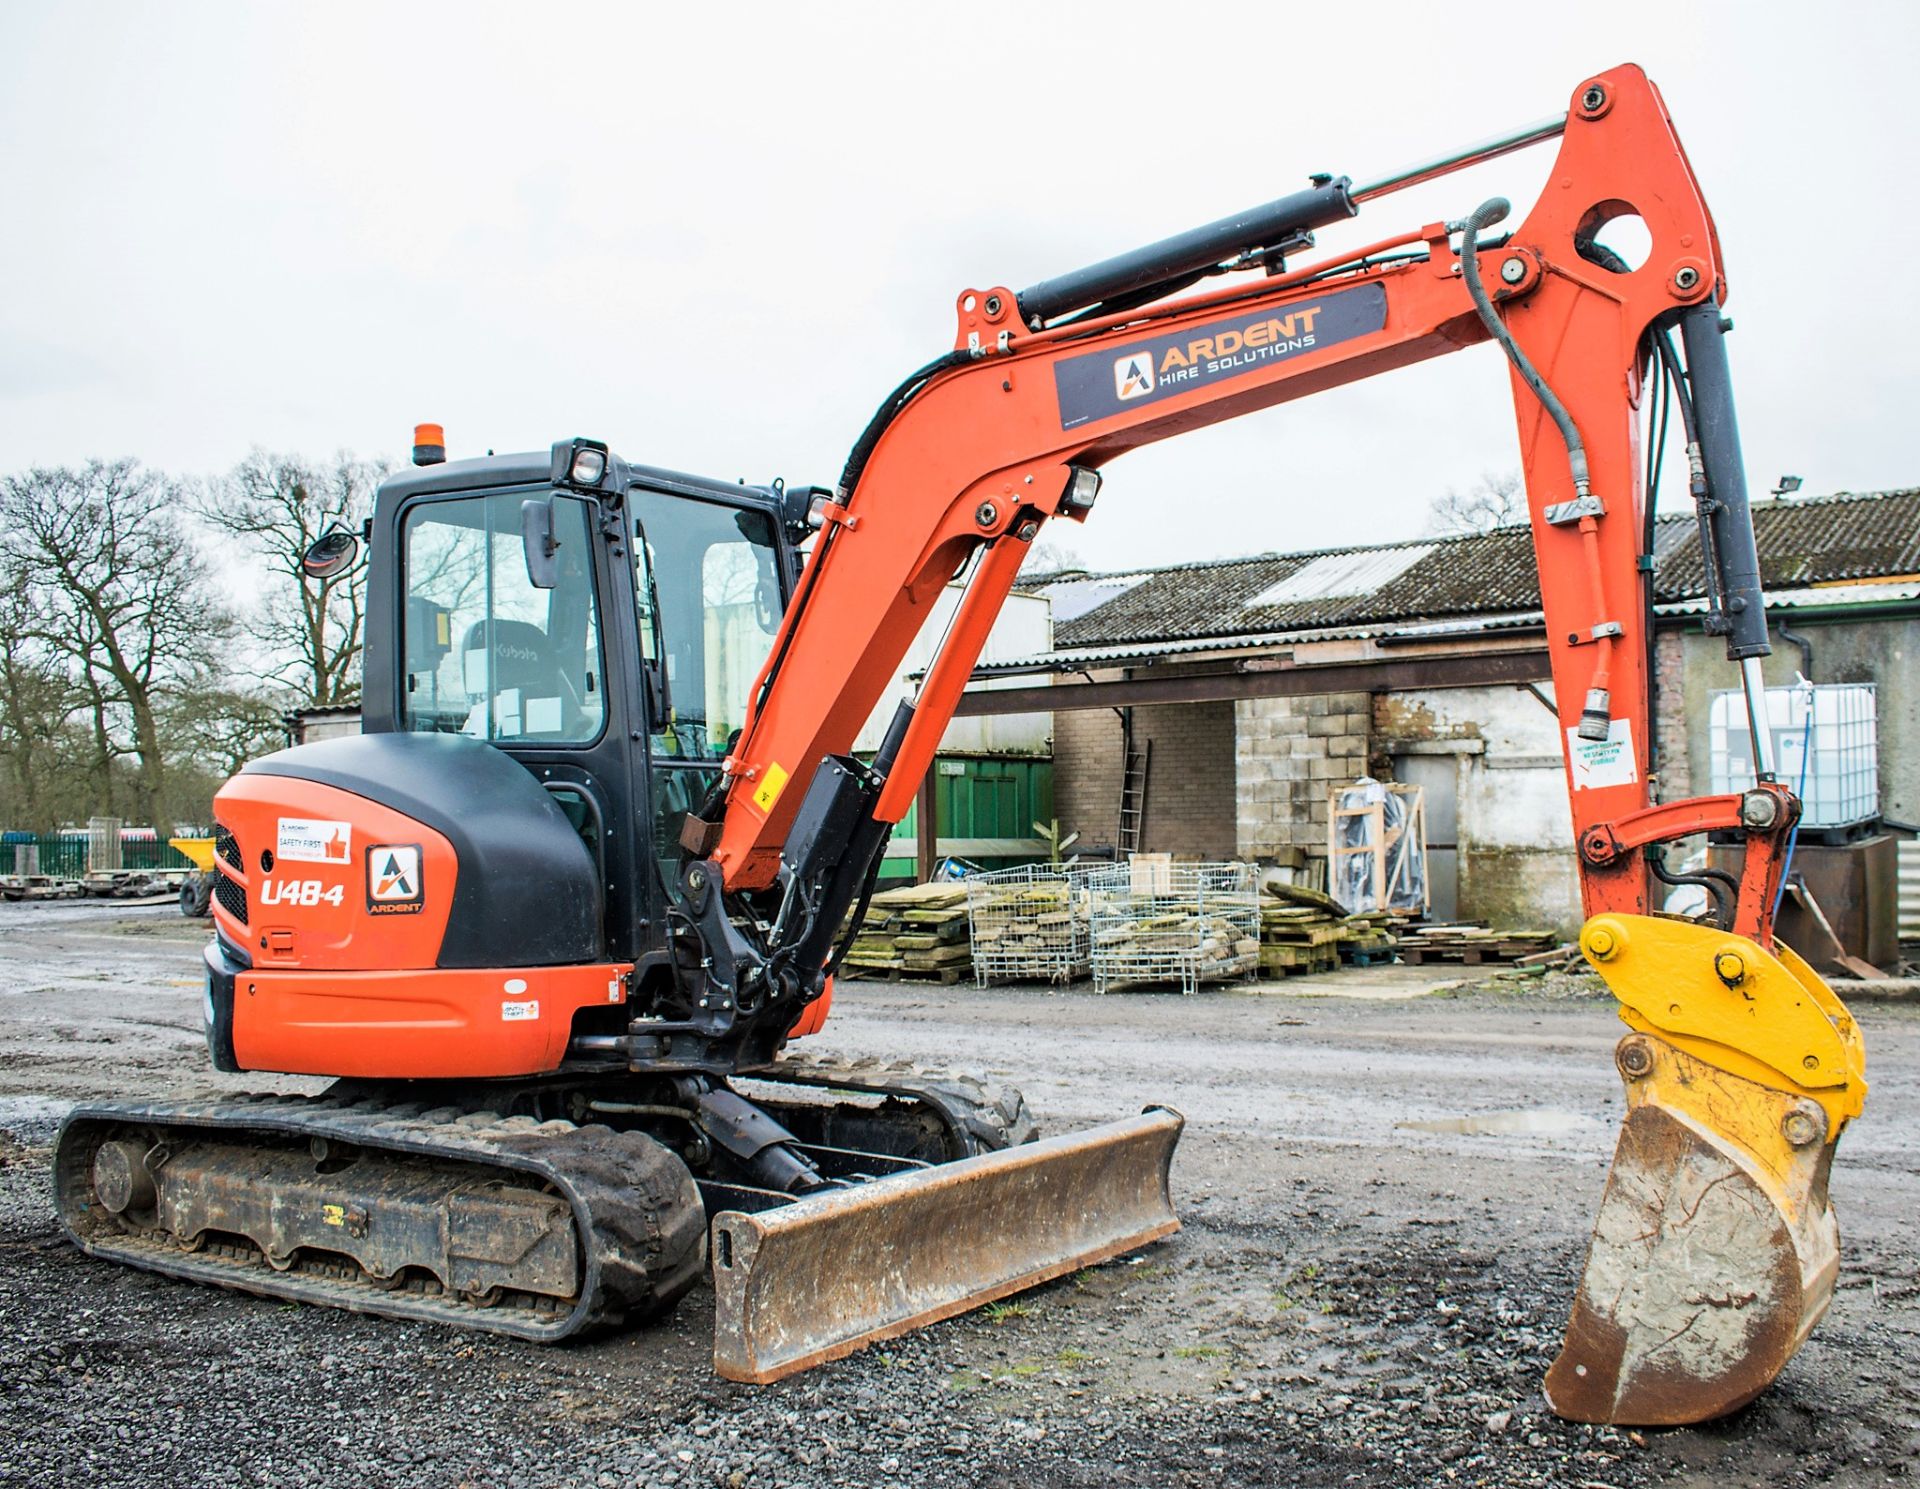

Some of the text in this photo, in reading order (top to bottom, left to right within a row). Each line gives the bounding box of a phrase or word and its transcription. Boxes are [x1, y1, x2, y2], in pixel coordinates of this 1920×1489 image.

[1159, 306, 1322, 374] ARDENT
[1159, 333, 1317, 387] HIRE SOLUTIONS
[279, 838, 321, 849] SAFETY FIRST
[260, 879, 345, 907] U48-4
[370, 903, 422, 913] ARDENT
